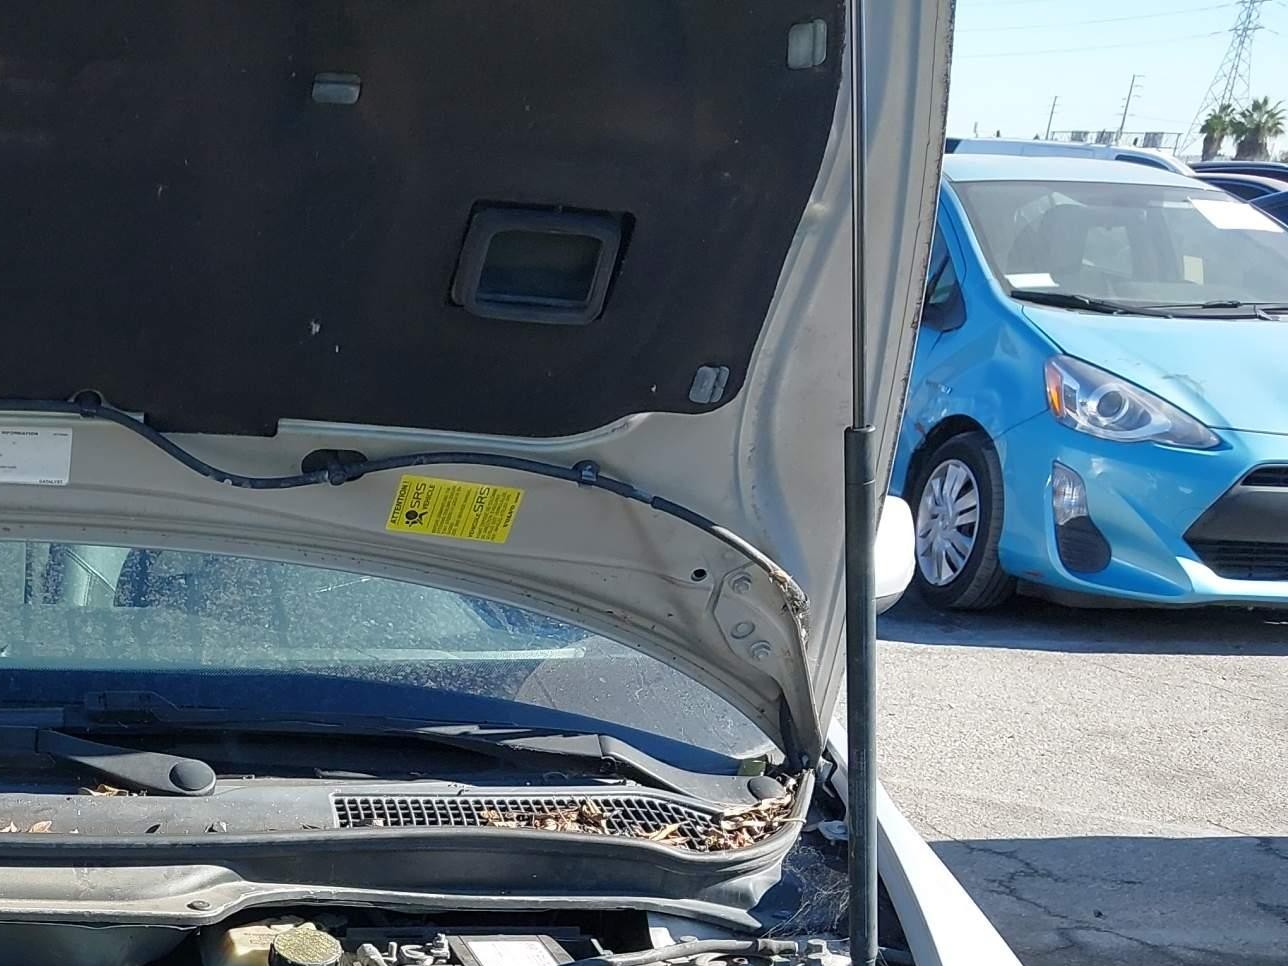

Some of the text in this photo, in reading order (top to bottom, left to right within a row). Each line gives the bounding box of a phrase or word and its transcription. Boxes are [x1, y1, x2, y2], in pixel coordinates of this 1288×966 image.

[409, 482, 427, 509] SRS
[423, 484, 436, 510] VEHICLE
[473, 486, 491, 513] SRS
